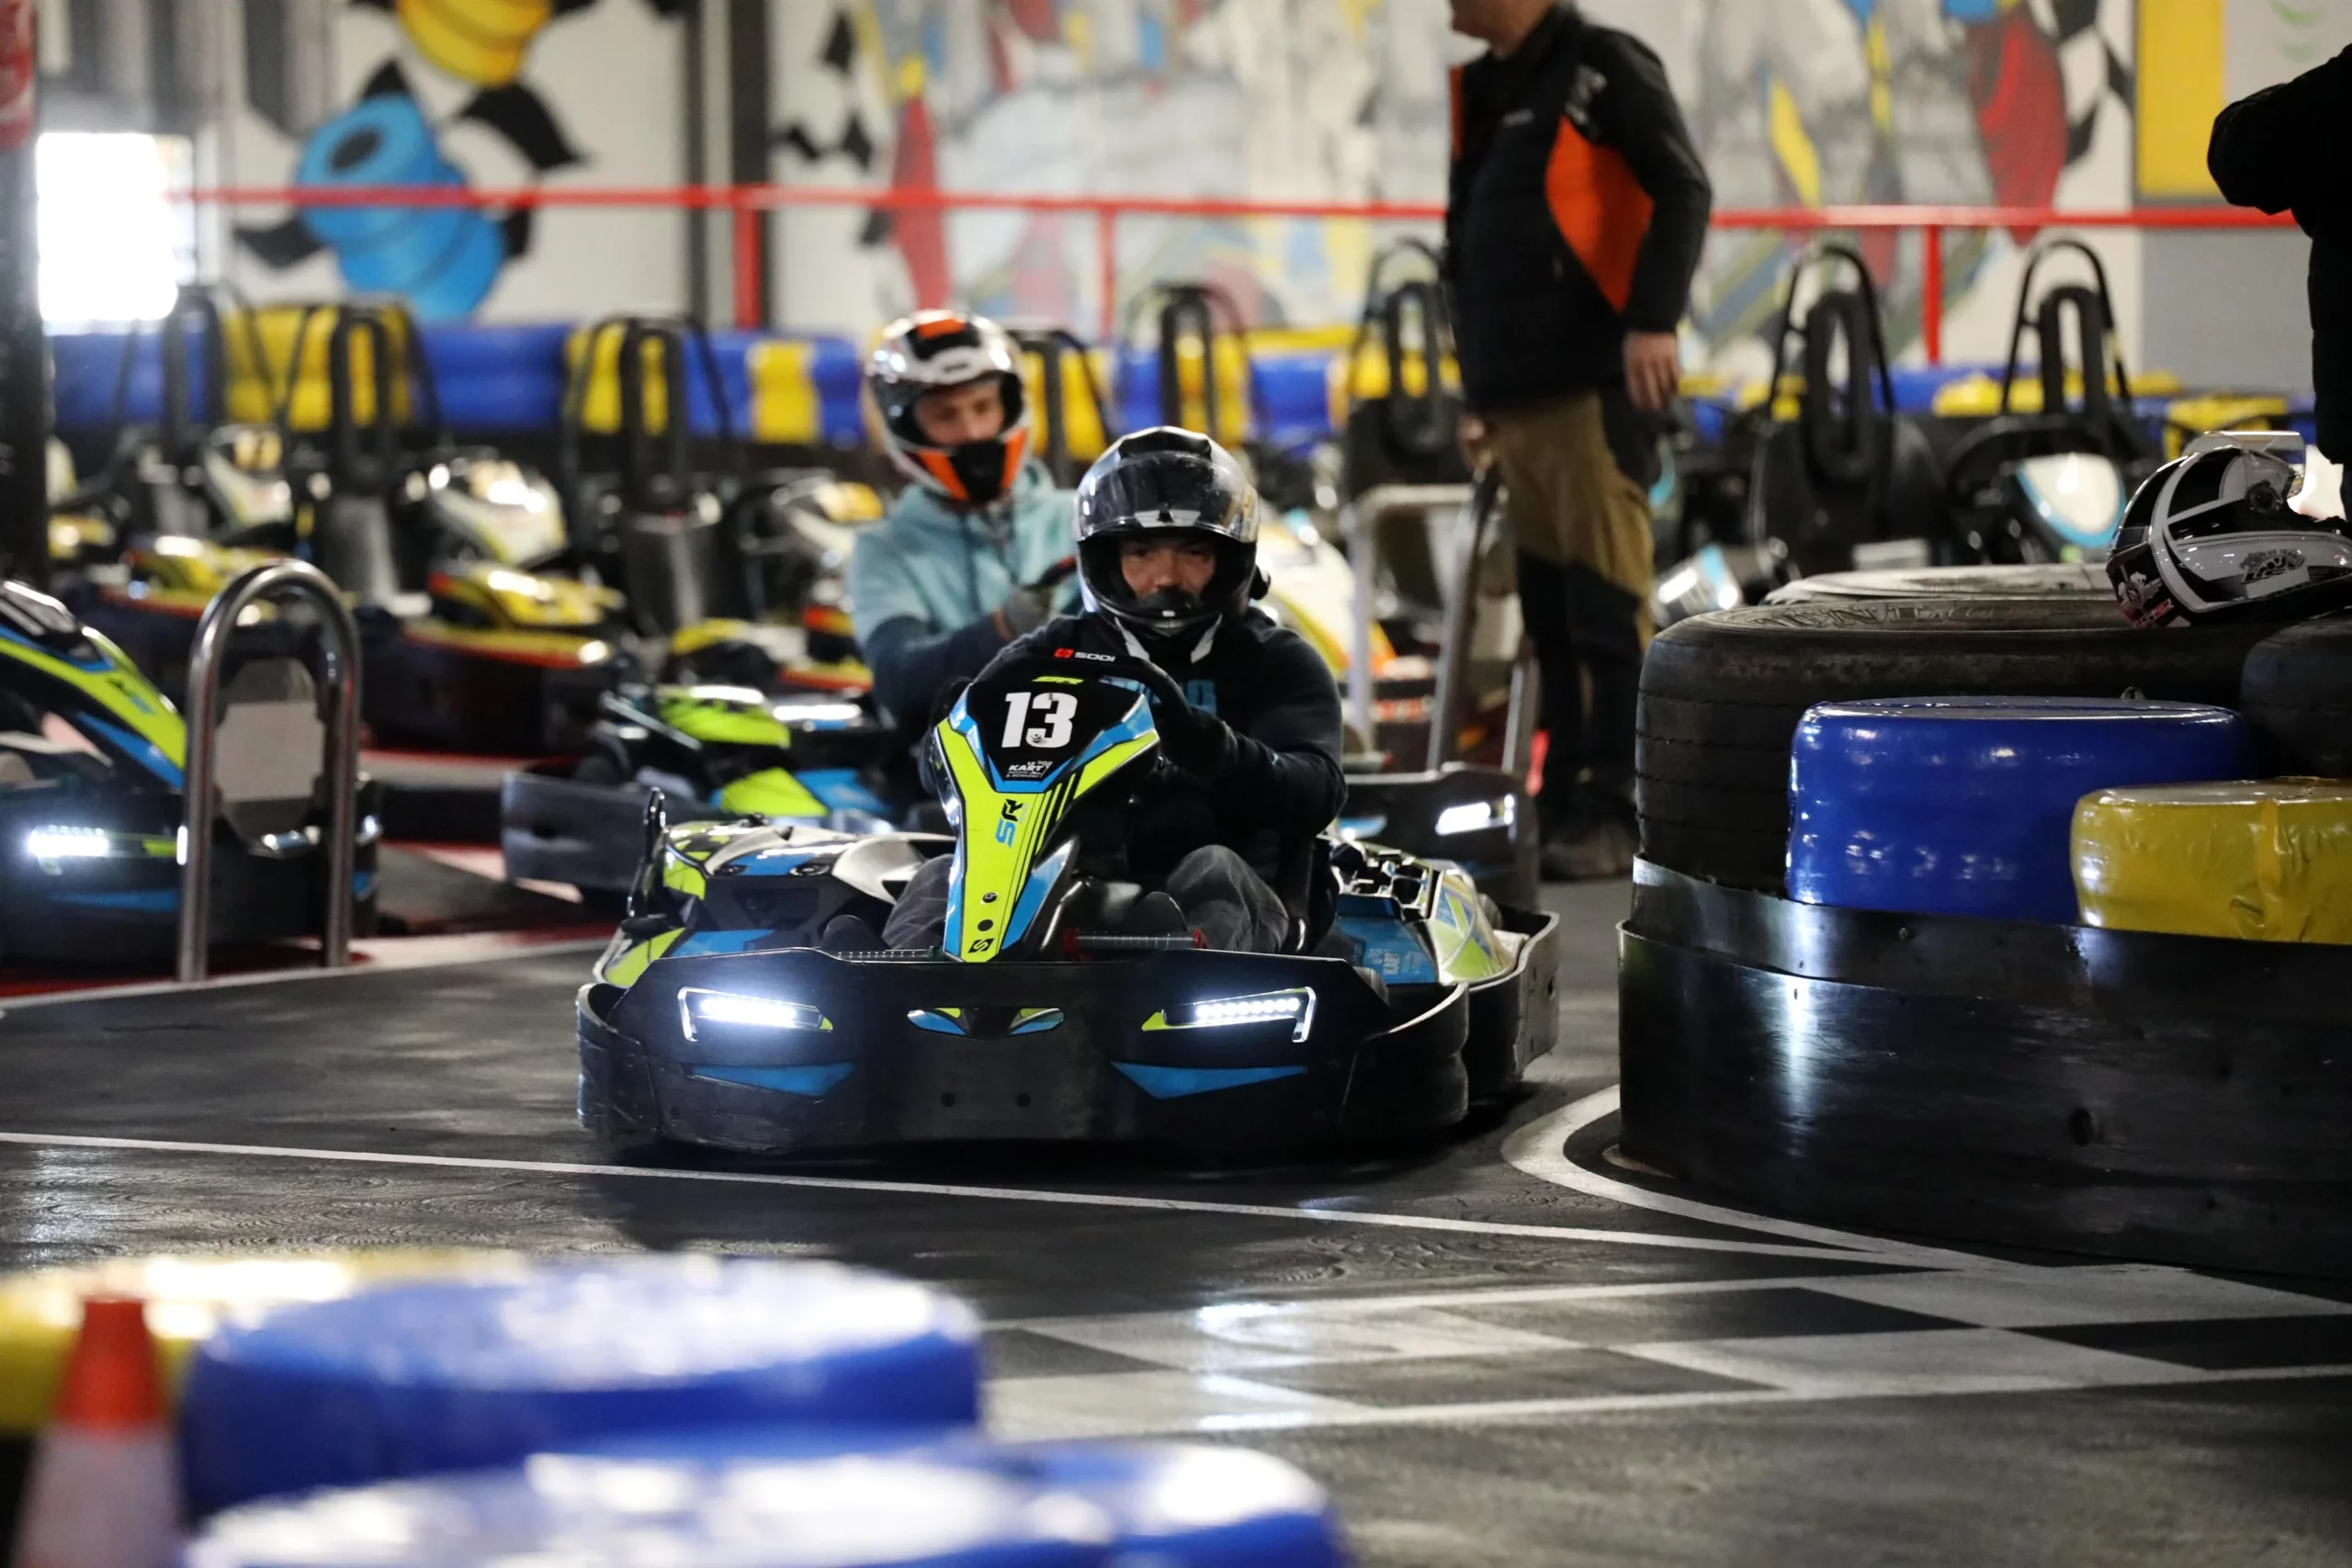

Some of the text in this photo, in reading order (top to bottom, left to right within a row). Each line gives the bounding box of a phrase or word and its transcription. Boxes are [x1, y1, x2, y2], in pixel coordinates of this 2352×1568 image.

[1745, 604, 2078, 629] DUNLO
[1074, 651, 1115, 662] SODI
[1001, 692, 1078, 749] 13
[995, 798, 1023, 849] SR
